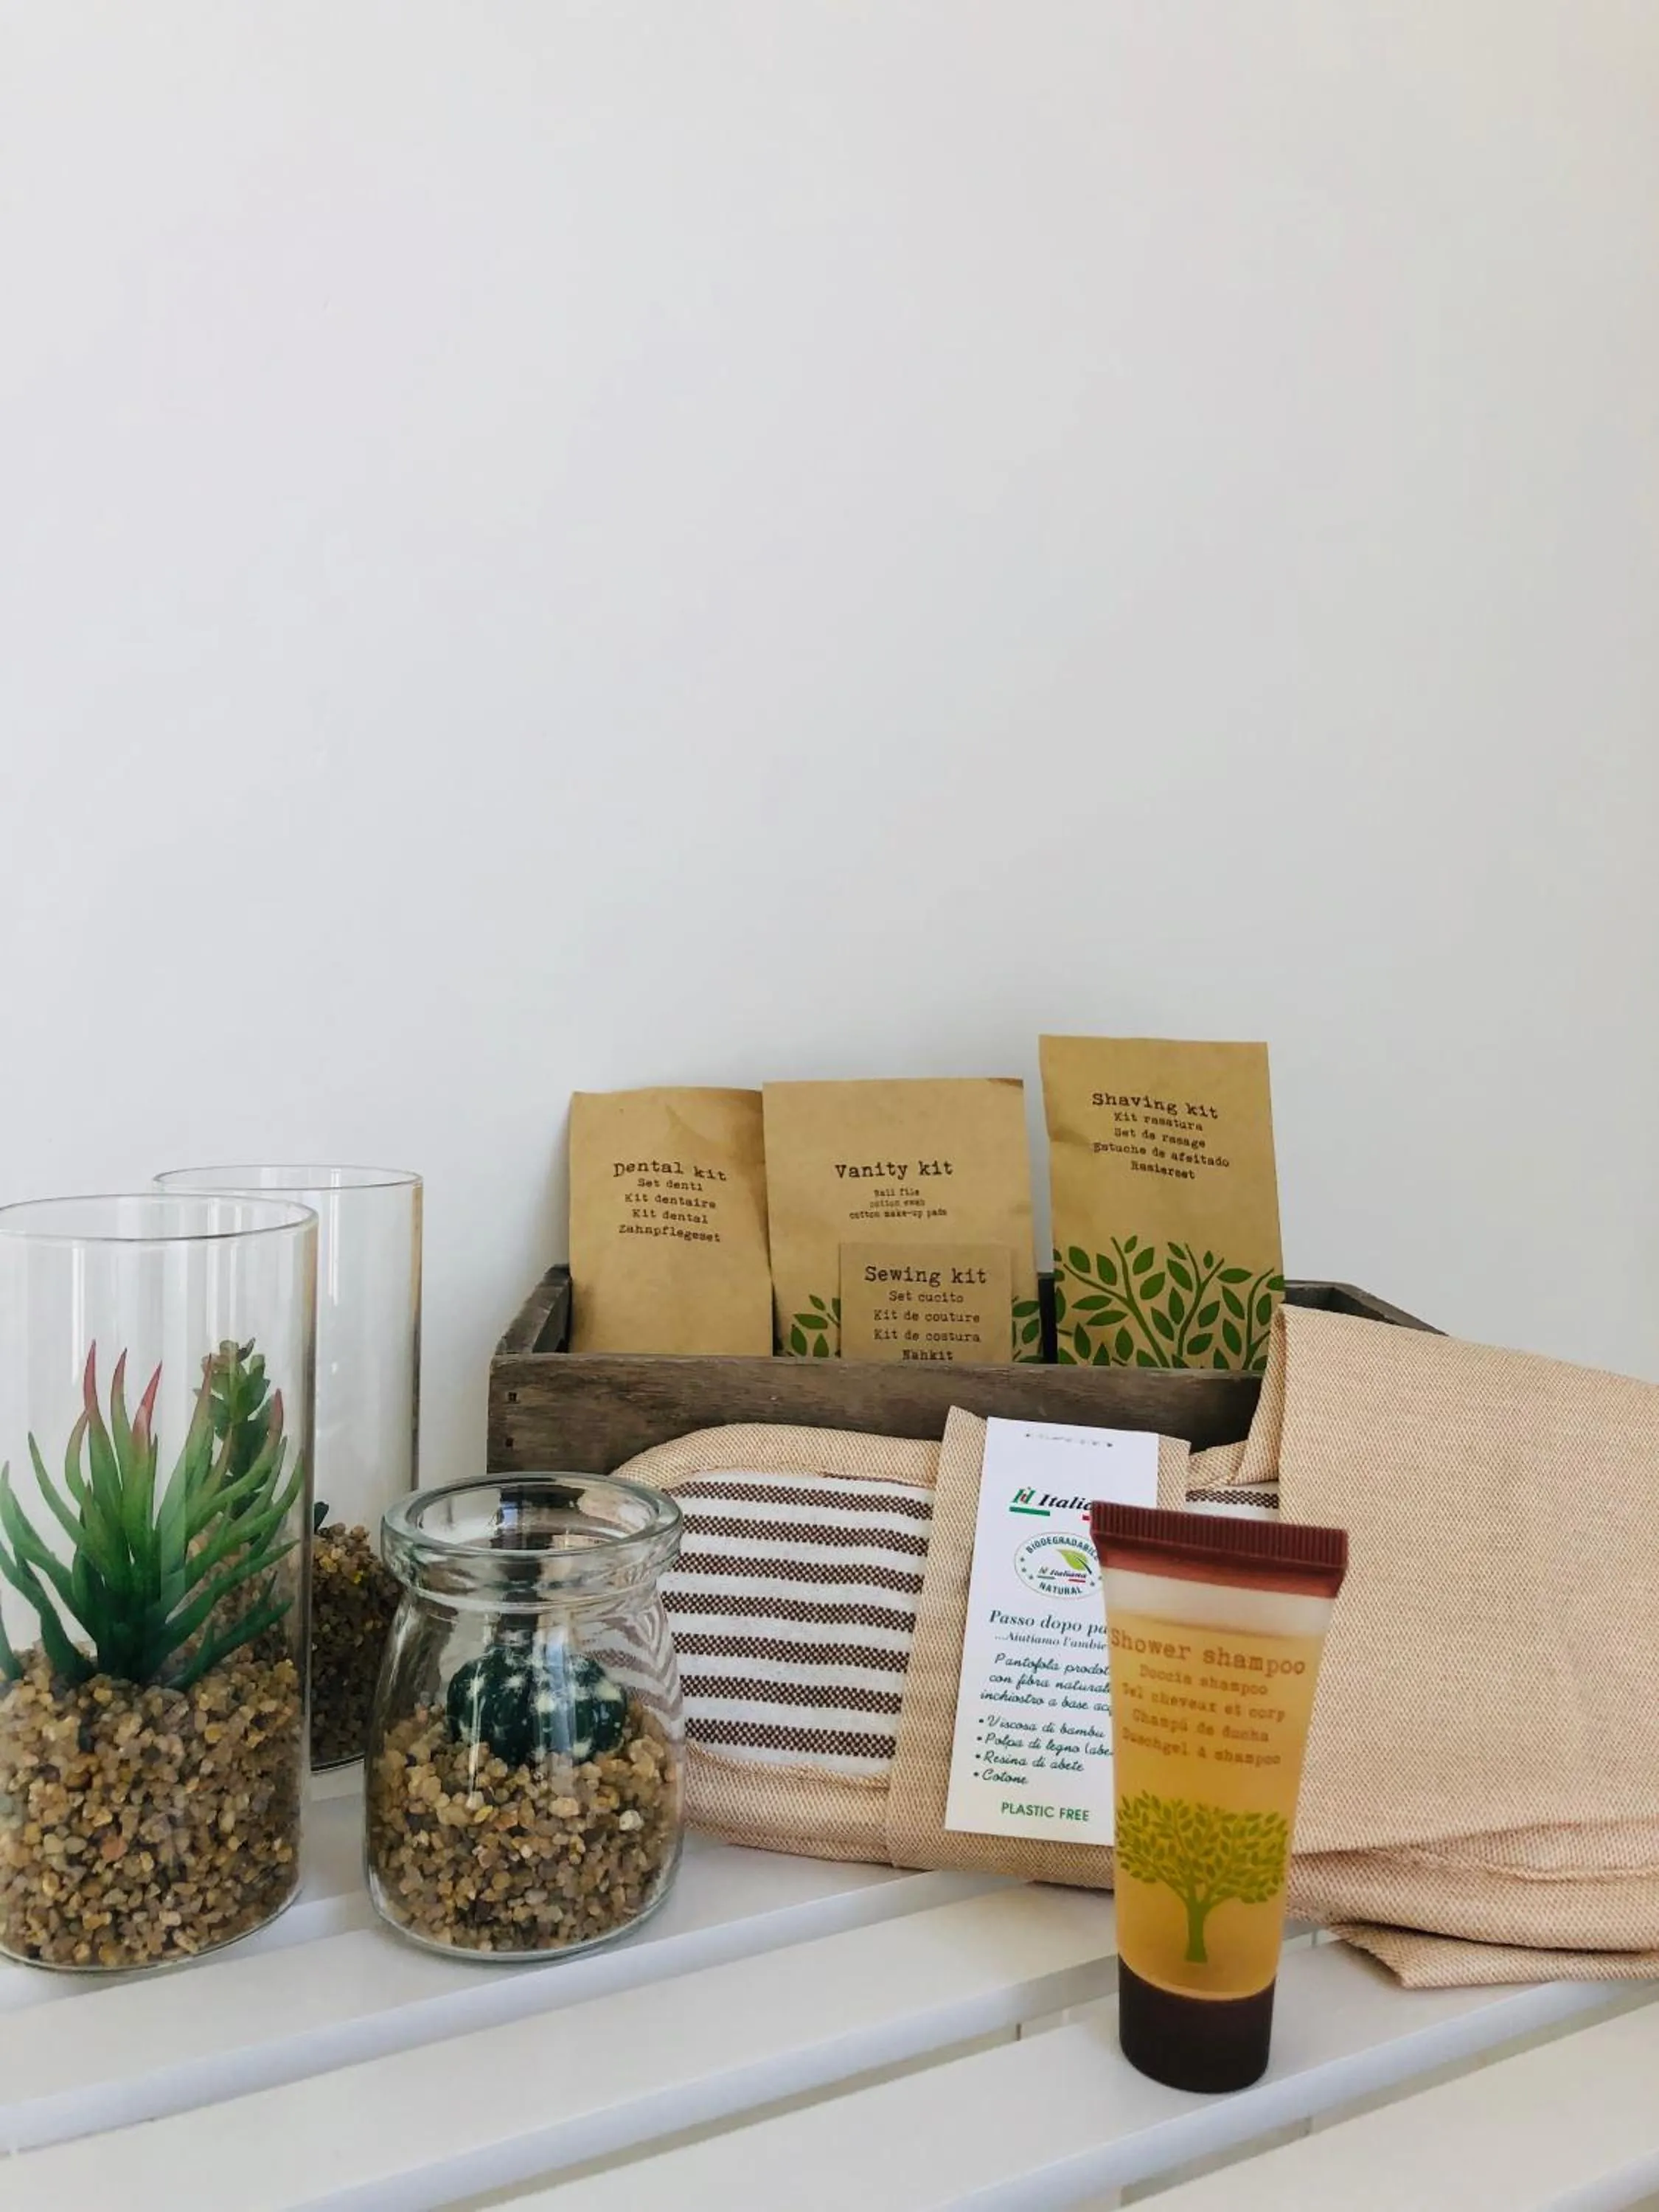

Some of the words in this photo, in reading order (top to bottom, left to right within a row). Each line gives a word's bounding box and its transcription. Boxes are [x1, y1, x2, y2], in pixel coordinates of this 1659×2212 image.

[1092, 1092, 1177, 1116] Shaving
[1186, 1103, 1218, 1119] kit
[1114, 1113, 1138, 1122] Kit
[1144, 1116, 1203, 1131] rasatura
[1114, 1128, 1136, 1137] Set
[1141, 1130, 1155, 1140] de
[1162, 1134, 1206, 1148] rasage
[1093, 1143, 1147, 1155] Estuche
[1152, 1148, 1165, 1159] de
[1171, 1152, 1229, 1167] afeitado
[613, 1160, 684, 1177] Dental
[693, 1166, 726, 1180] kit
[835, 1162, 908, 1180] Vanity
[919, 1161, 953, 1175] kit
[637, 1178, 661, 1187] Set
[666, 1180, 703, 1192] denti
[625, 1194, 648, 1203] Kit
[655, 1195, 716, 1208] dentaire
[632, 1208, 656, 1218] Kit
[662, 1211, 708, 1224] dental
[619, 1224, 720, 1242] Zahnpflegeset
[864, 1266, 941, 1287] Sewing
[951, 1268, 987, 1284] kit
[889, 1290, 912, 1301] Set
[918, 1292, 964, 1303] cucito
[874, 1310, 897, 1321] Kit
[903, 1310, 919, 1321] de
[925, 1312, 980, 1323] couture
[874, 1329, 897, 1340] Kit
[904, 1329, 919, 1341] de
[926, 1332, 981, 1343] costura
[1039, 1582, 1082, 1595] NATURAL
[990, 1610, 1035, 1626] Passo
[1040, 1615, 1082, 1634] dopo
[1110, 1627, 1191, 1660] Shower
[1203, 1646, 1305, 1677] shampoo
[995, 1653, 1060, 1674] Pantofola
[1064, 1660, 1109, 1675] prodot
[989, 1674, 1013, 1683] con
[1017, 1674, 1050, 1690] fibra
[1200, 1675, 1268, 1697] shampoo
[980, 1689, 1044, 1705] inchiostro
[1048, 1698, 1057, 1707] a
[1062, 1696, 1088, 1710] base
[1224, 1704, 1241, 1717] et
[987, 1714, 1037, 1731] Viscosa
[1042, 1722, 1054, 1733] di
[984, 1733, 1023, 1749] Polpa
[1028, 1738, 1041, 1749] di
[1046, 1740, 1080, 1756] legno
[983, 1750, 1027, 1766] Resina
[1032, 1757, 1046, 1767] di
[1050, 1757, 1085, 1772] abete
[981, 1768, 1029, 1784] Cotone
[1001, 1802, 1054, 1818] PLASTIC
[1060, 1808, 1090, 1821] FREE
